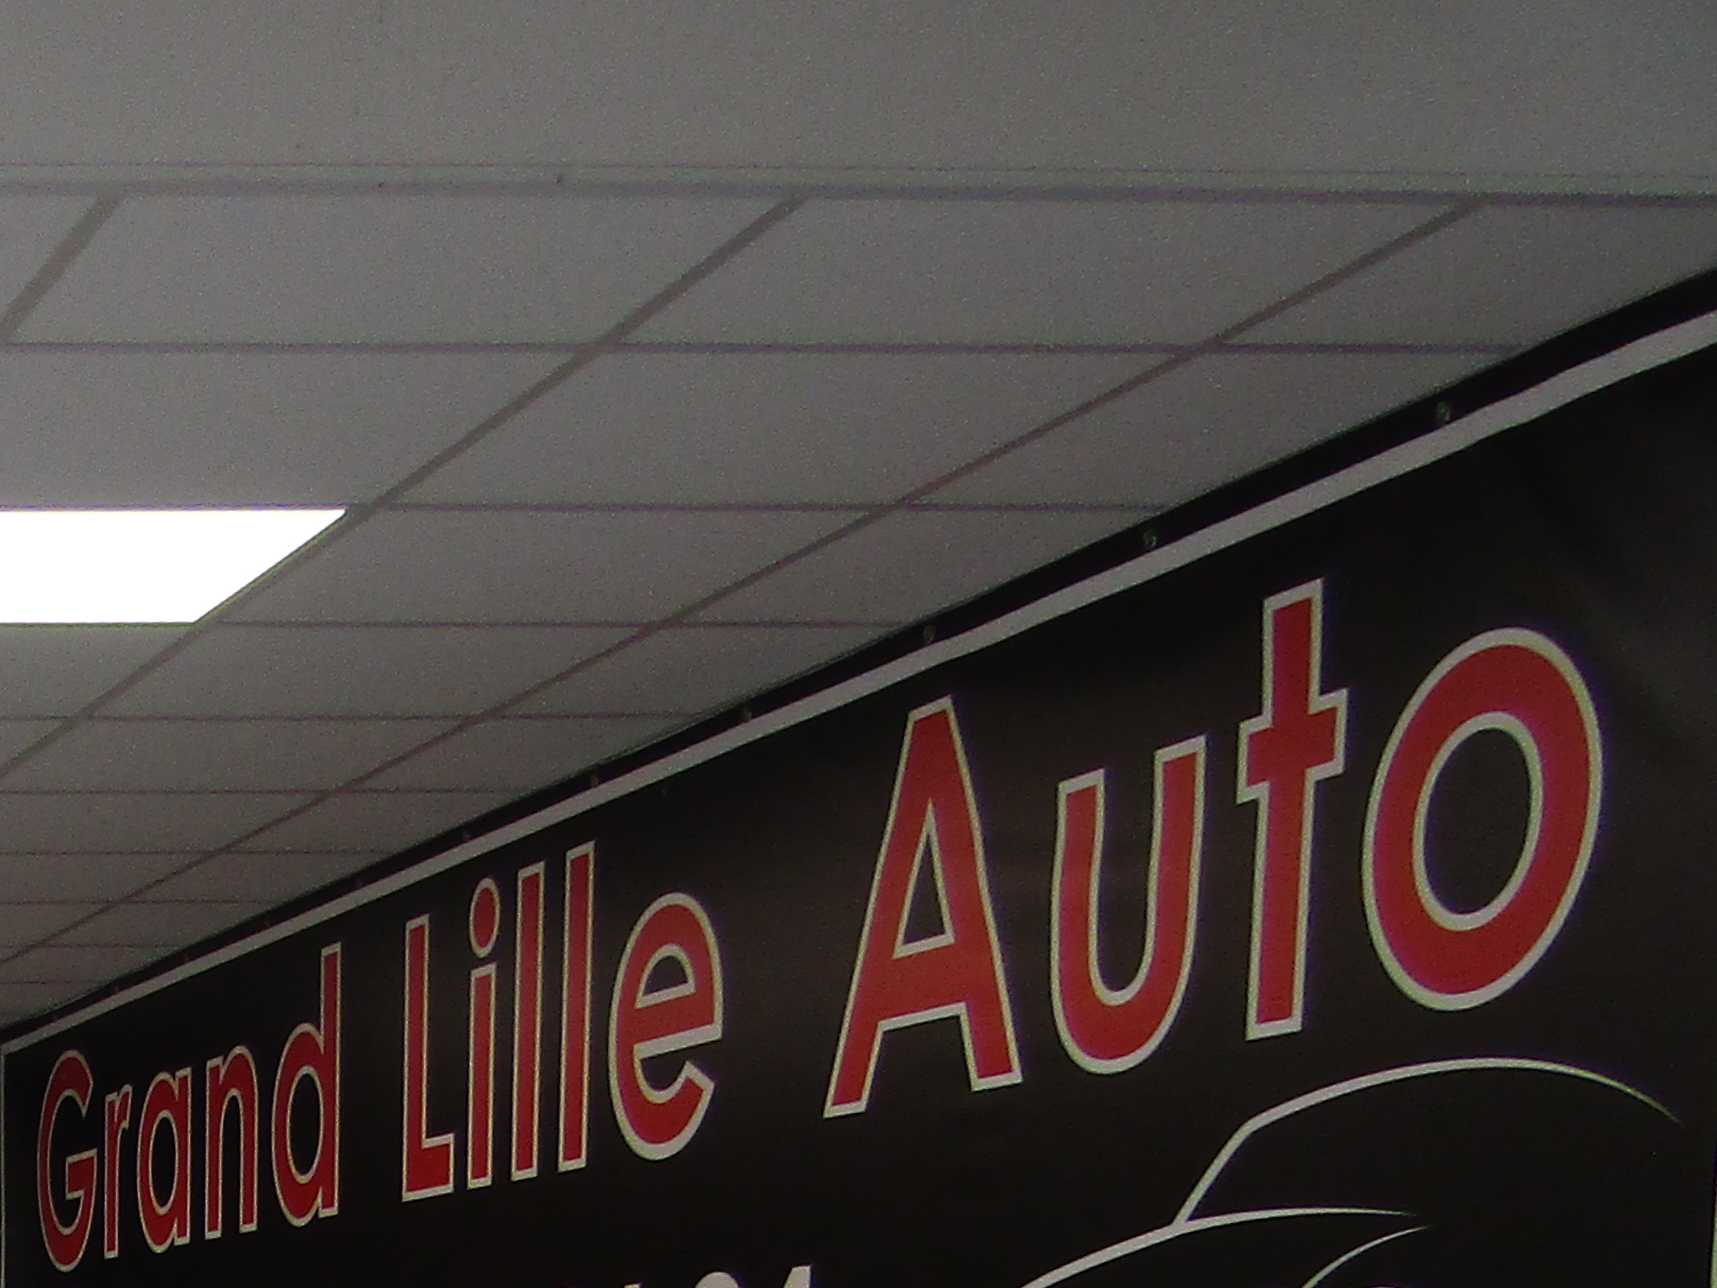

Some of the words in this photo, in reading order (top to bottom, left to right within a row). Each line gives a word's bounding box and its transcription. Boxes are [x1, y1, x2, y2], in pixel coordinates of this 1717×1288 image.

[37, 943, 342, 1272] Grand
[402, 840, 724, 1202] Lille
[823, 577, 1603, 1118] Auto
